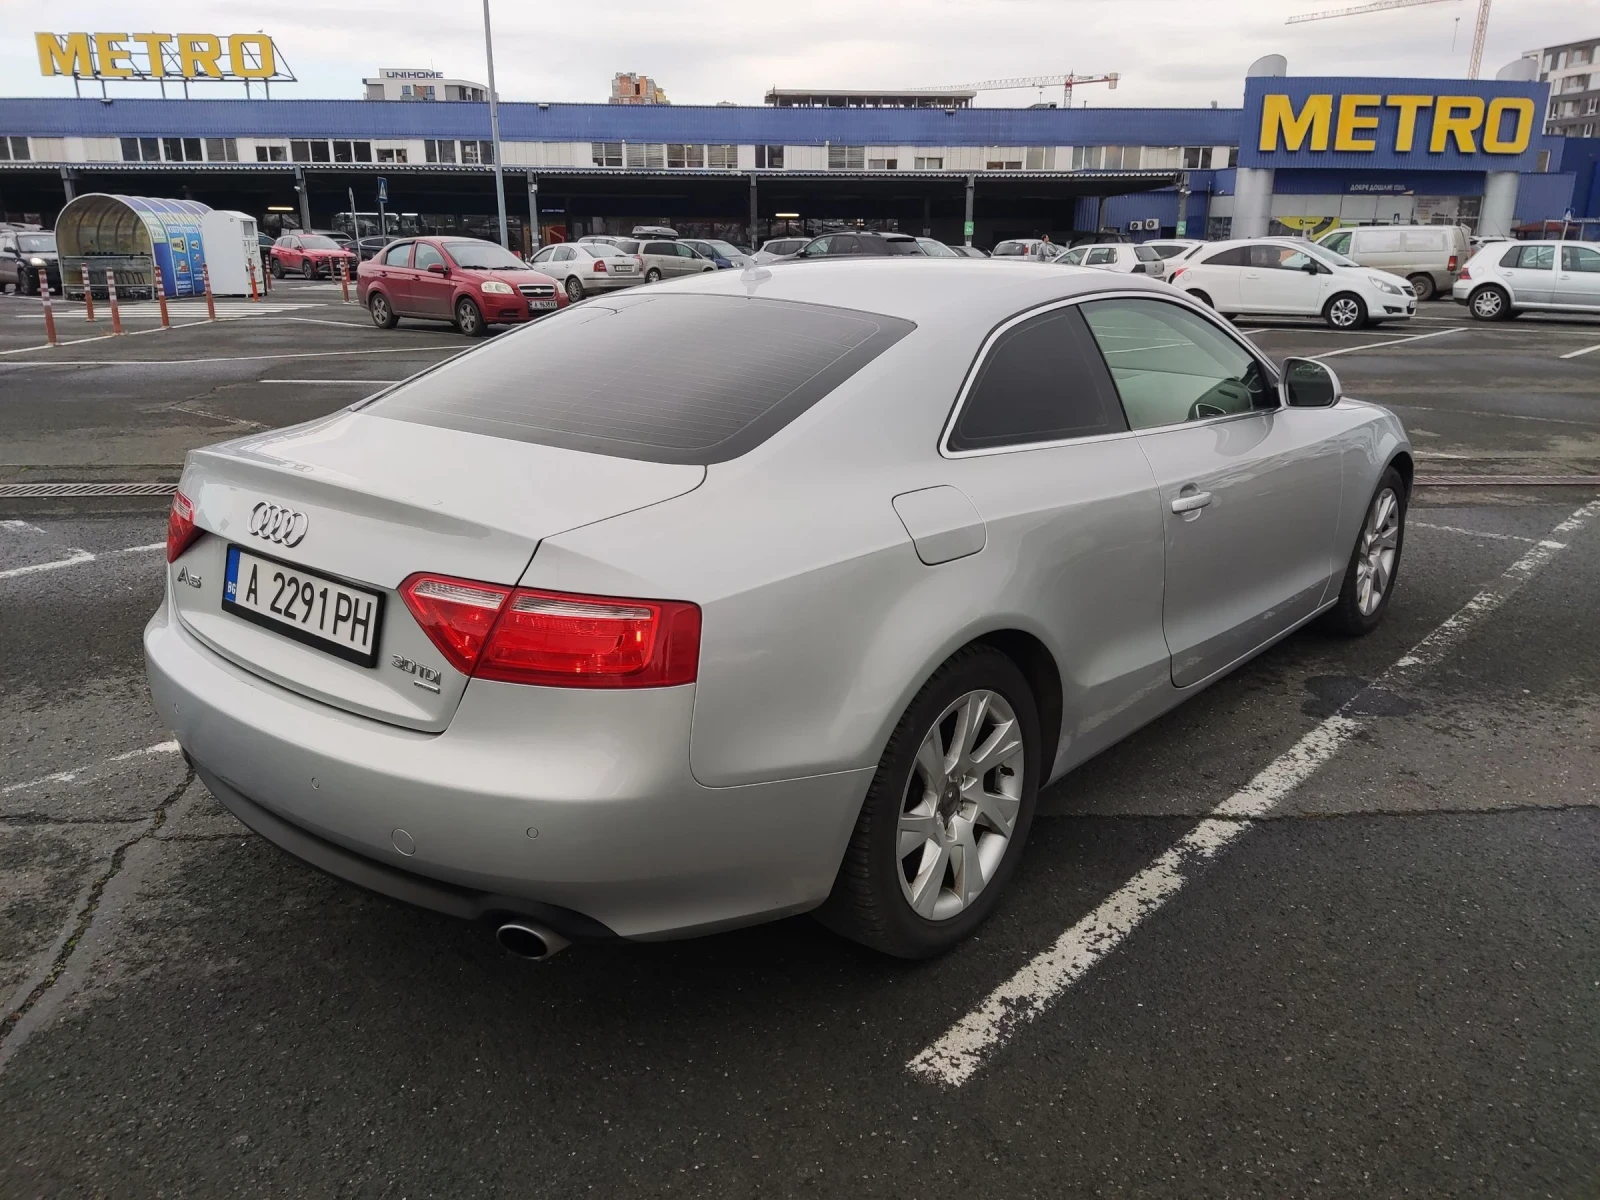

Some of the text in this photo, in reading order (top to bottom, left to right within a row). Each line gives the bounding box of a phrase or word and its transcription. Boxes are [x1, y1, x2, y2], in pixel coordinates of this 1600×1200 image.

[34, 32, 277, 79] METRO
[386, 71, 444, 79] UNIHOME
[1259, 94, 1535, 154] METRO
[177, 565, 202, 589] A5
[227, 581, 237, 595] BG
[246, 563, 258, 606] A
[416, 663, 441, 686] TDI
